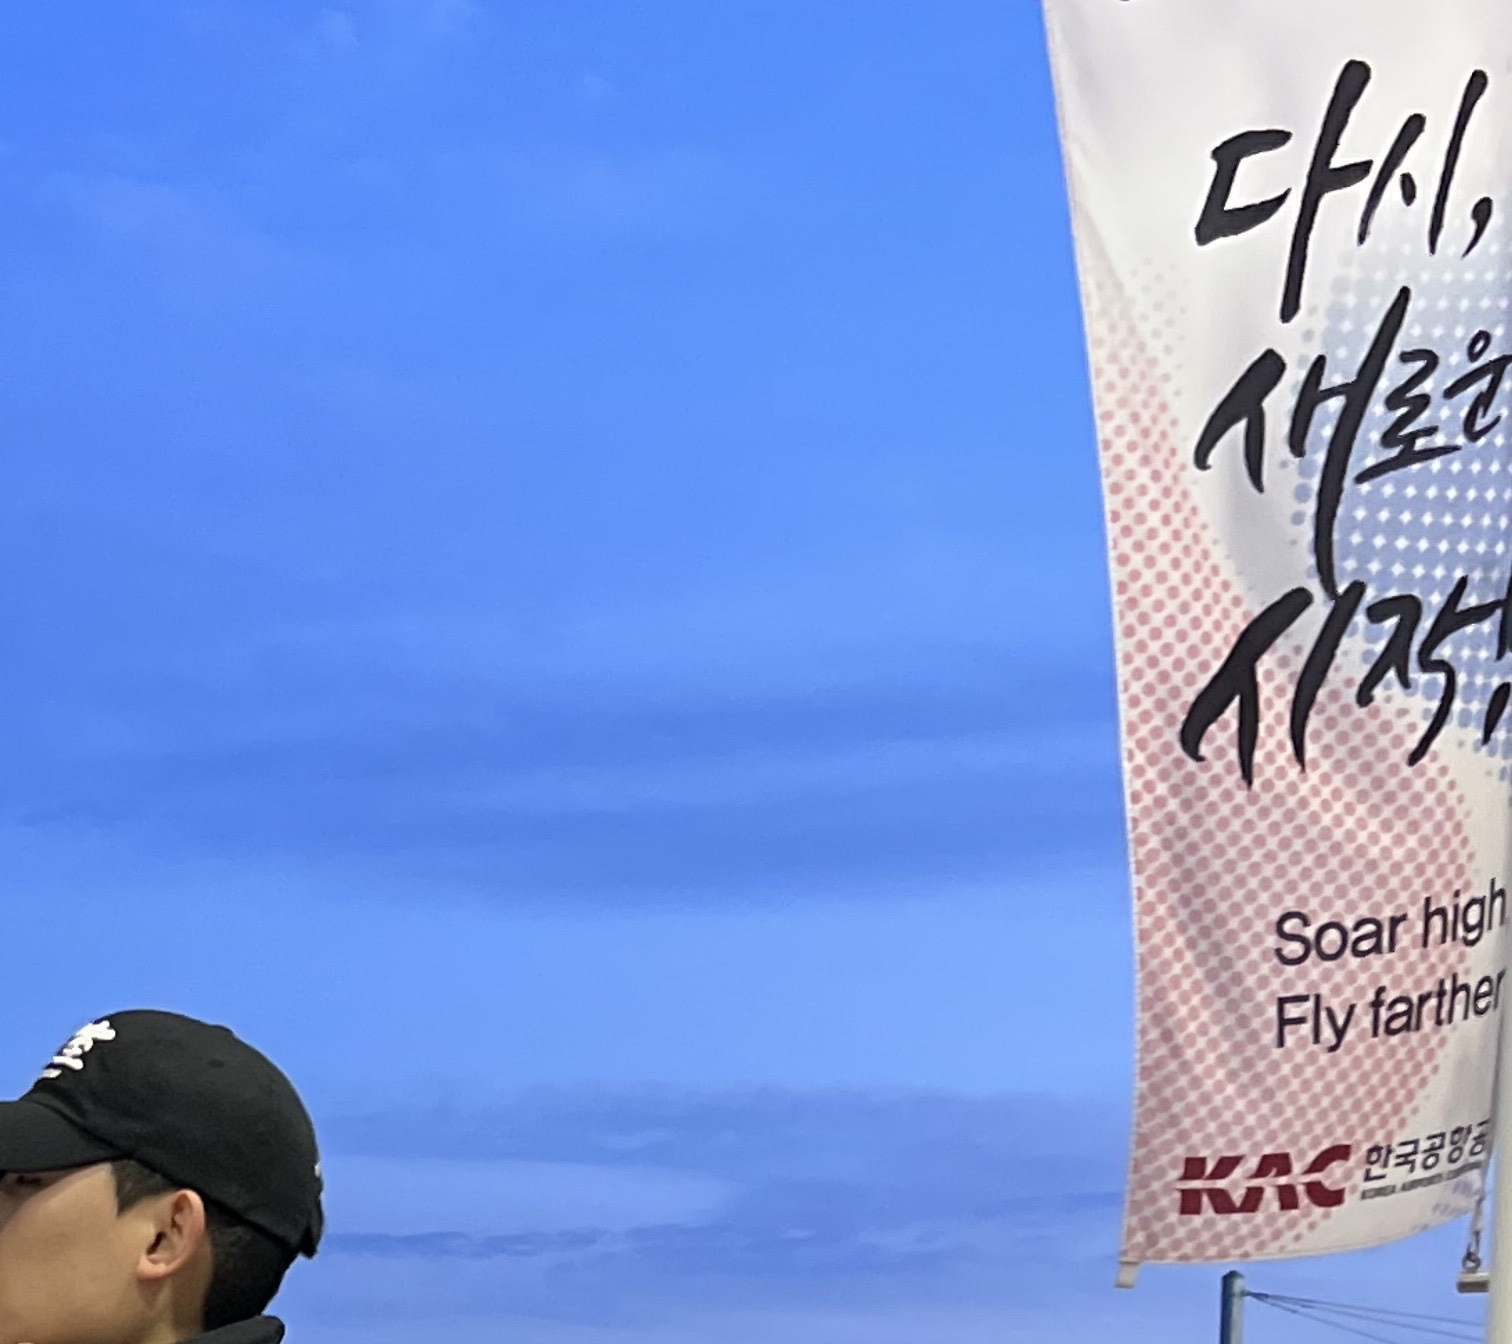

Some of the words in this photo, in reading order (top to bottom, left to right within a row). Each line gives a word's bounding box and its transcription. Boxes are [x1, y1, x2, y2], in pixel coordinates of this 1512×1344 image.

[1195, 59, 1493, 323] 다시,
[1194, 286, 1512, 600] 새로운
[1275, 911, 1407, 966] Soar
[1422, 877, 1506, 947] high
[1276, 993, 1356, 1053] Fly
[1370, 968, 1506, 1038] farther
[1176, 1144, 1351, 1215] KAC
